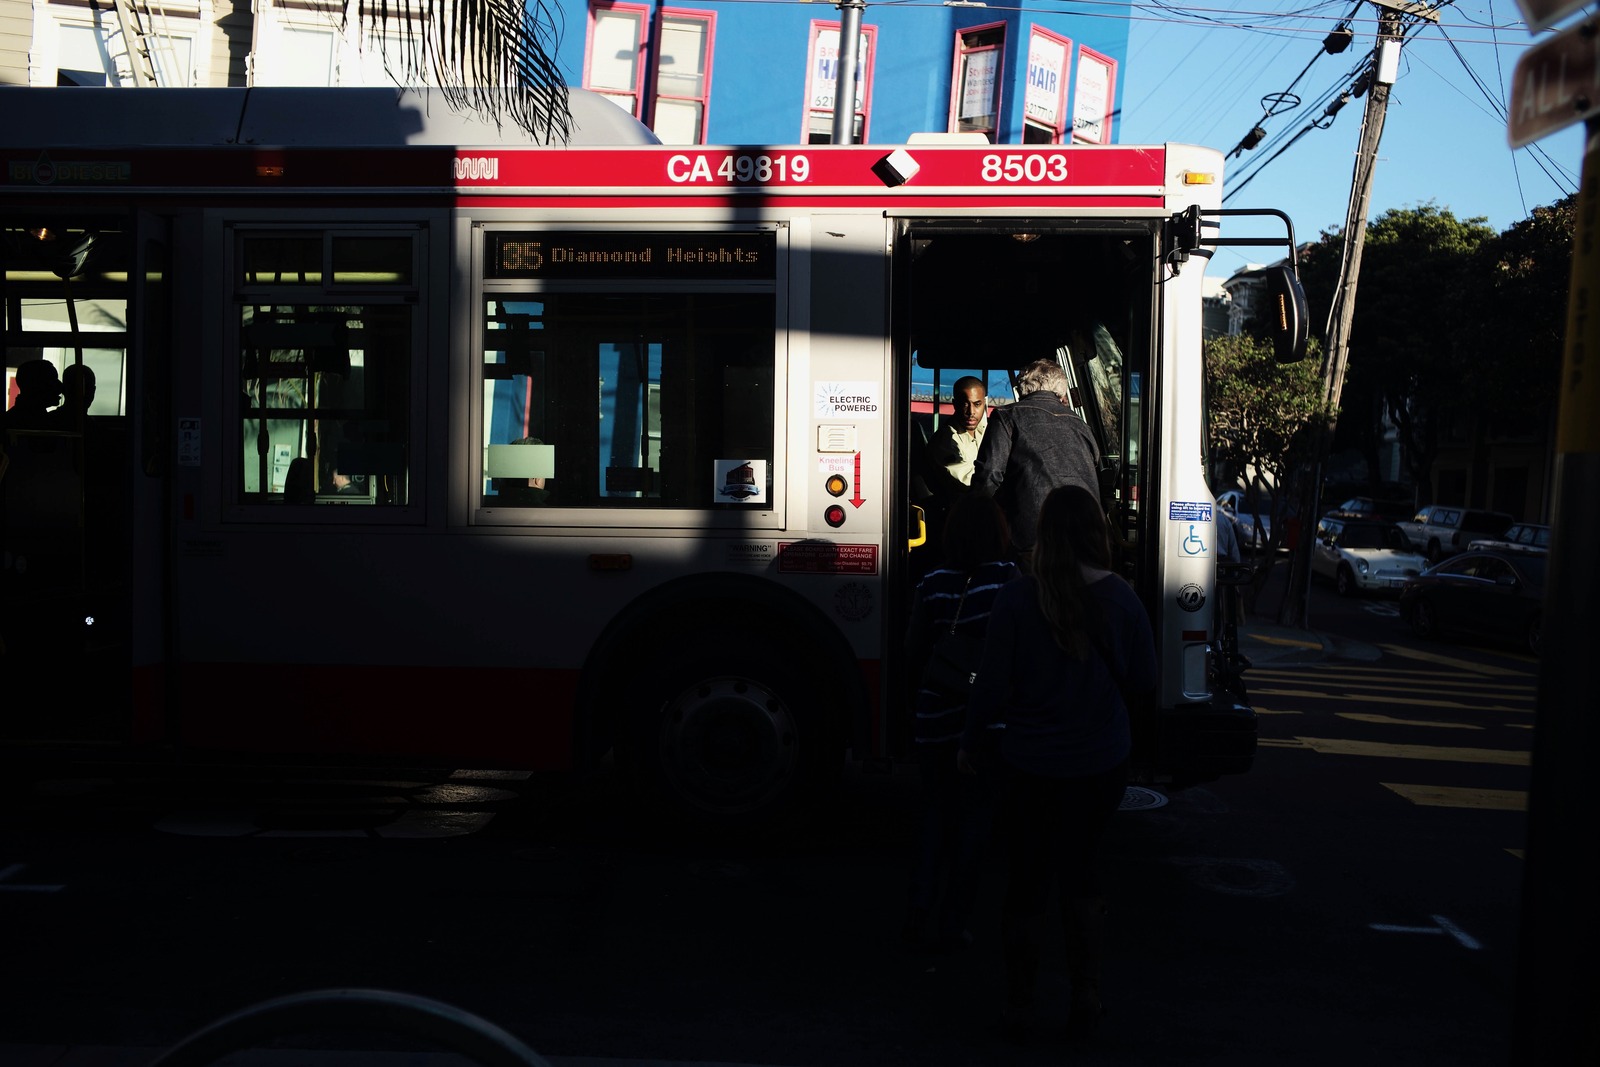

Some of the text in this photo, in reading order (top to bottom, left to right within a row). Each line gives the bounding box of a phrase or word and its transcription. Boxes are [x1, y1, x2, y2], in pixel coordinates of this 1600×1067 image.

[1029, 63, 1057, 93] HAIR
[1518, 52, 1571, 122] ALL
[667, 154, 810, 182] CA 49819
[981, 154, 1068, 182] 8503
[503, 242, 759, 270] 35 Diamond Heights
[829, 396, 871, 404] ELECTRIC
[819, 457, 854, 466] Kneeling
